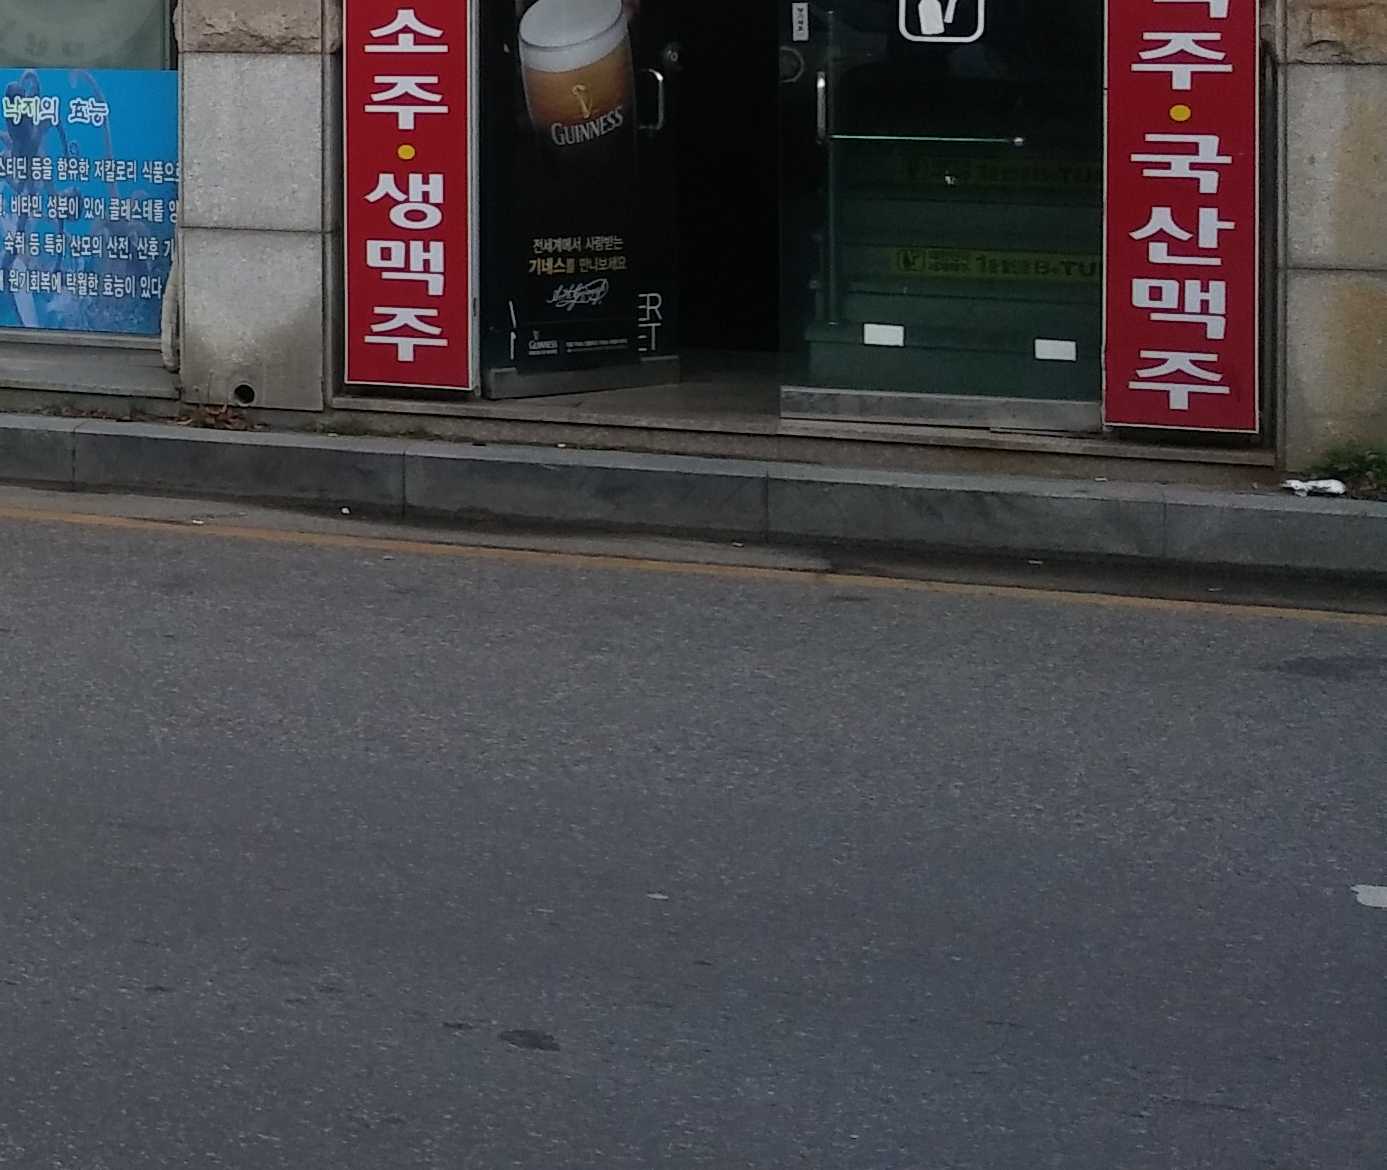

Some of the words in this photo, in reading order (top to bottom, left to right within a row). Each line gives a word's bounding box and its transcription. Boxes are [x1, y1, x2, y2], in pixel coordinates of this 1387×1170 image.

[68, 97, 109, 126] 효능
[551, 106, 623, 147] GUINNESS
[31, 157, 52, 180] 등을
[57, 158, 89, 181] 함유한
[94, 160, 137, 183] 저칼로리
[11, 195, 43, 218] 비타민
[47, 196, 79, 219] 성분이
[83, 197, 105, 220] 있어
[109, 198, 164, 223] 콜레스테롤
[4, 232, 25, 255] 숙취
[45, 233, 66, 256] 특히
[70, 234, 103, 258] 산모의
[137, 237, 159, 261] 산후
[532, 237, 582, 254] 전세계에서
[585, 235, 625, 251] 사랑받는
[8, 269, 62, 294] 원기회복에
[66, 272, 99, 297] 탁월한
[103, 274, 135, 298] 효능이
[140, 276, 162, 299] 있다
